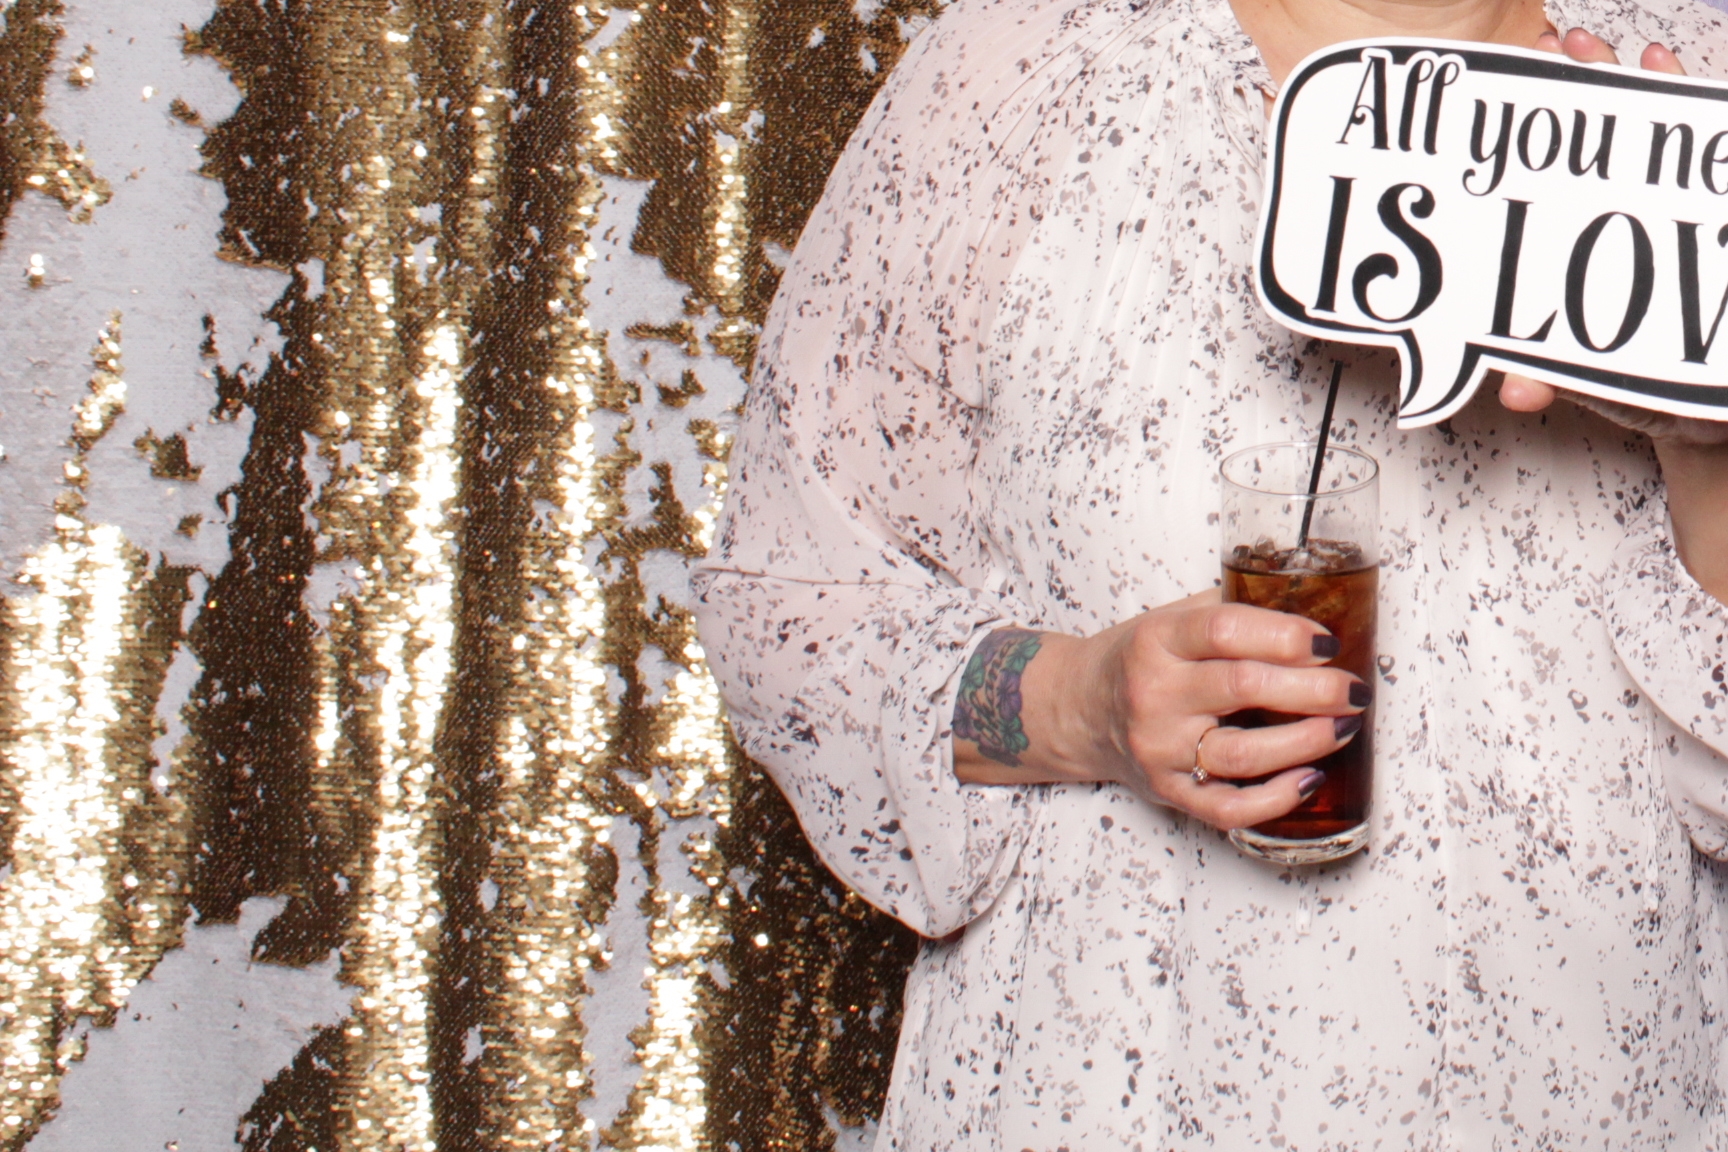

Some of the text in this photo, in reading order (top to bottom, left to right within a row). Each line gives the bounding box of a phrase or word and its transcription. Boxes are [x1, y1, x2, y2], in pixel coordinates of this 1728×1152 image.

[1336, 56, 1460, 155] All
[1462, 99, 1617, 196] you
[1311, 175, 1443, 324] IS
